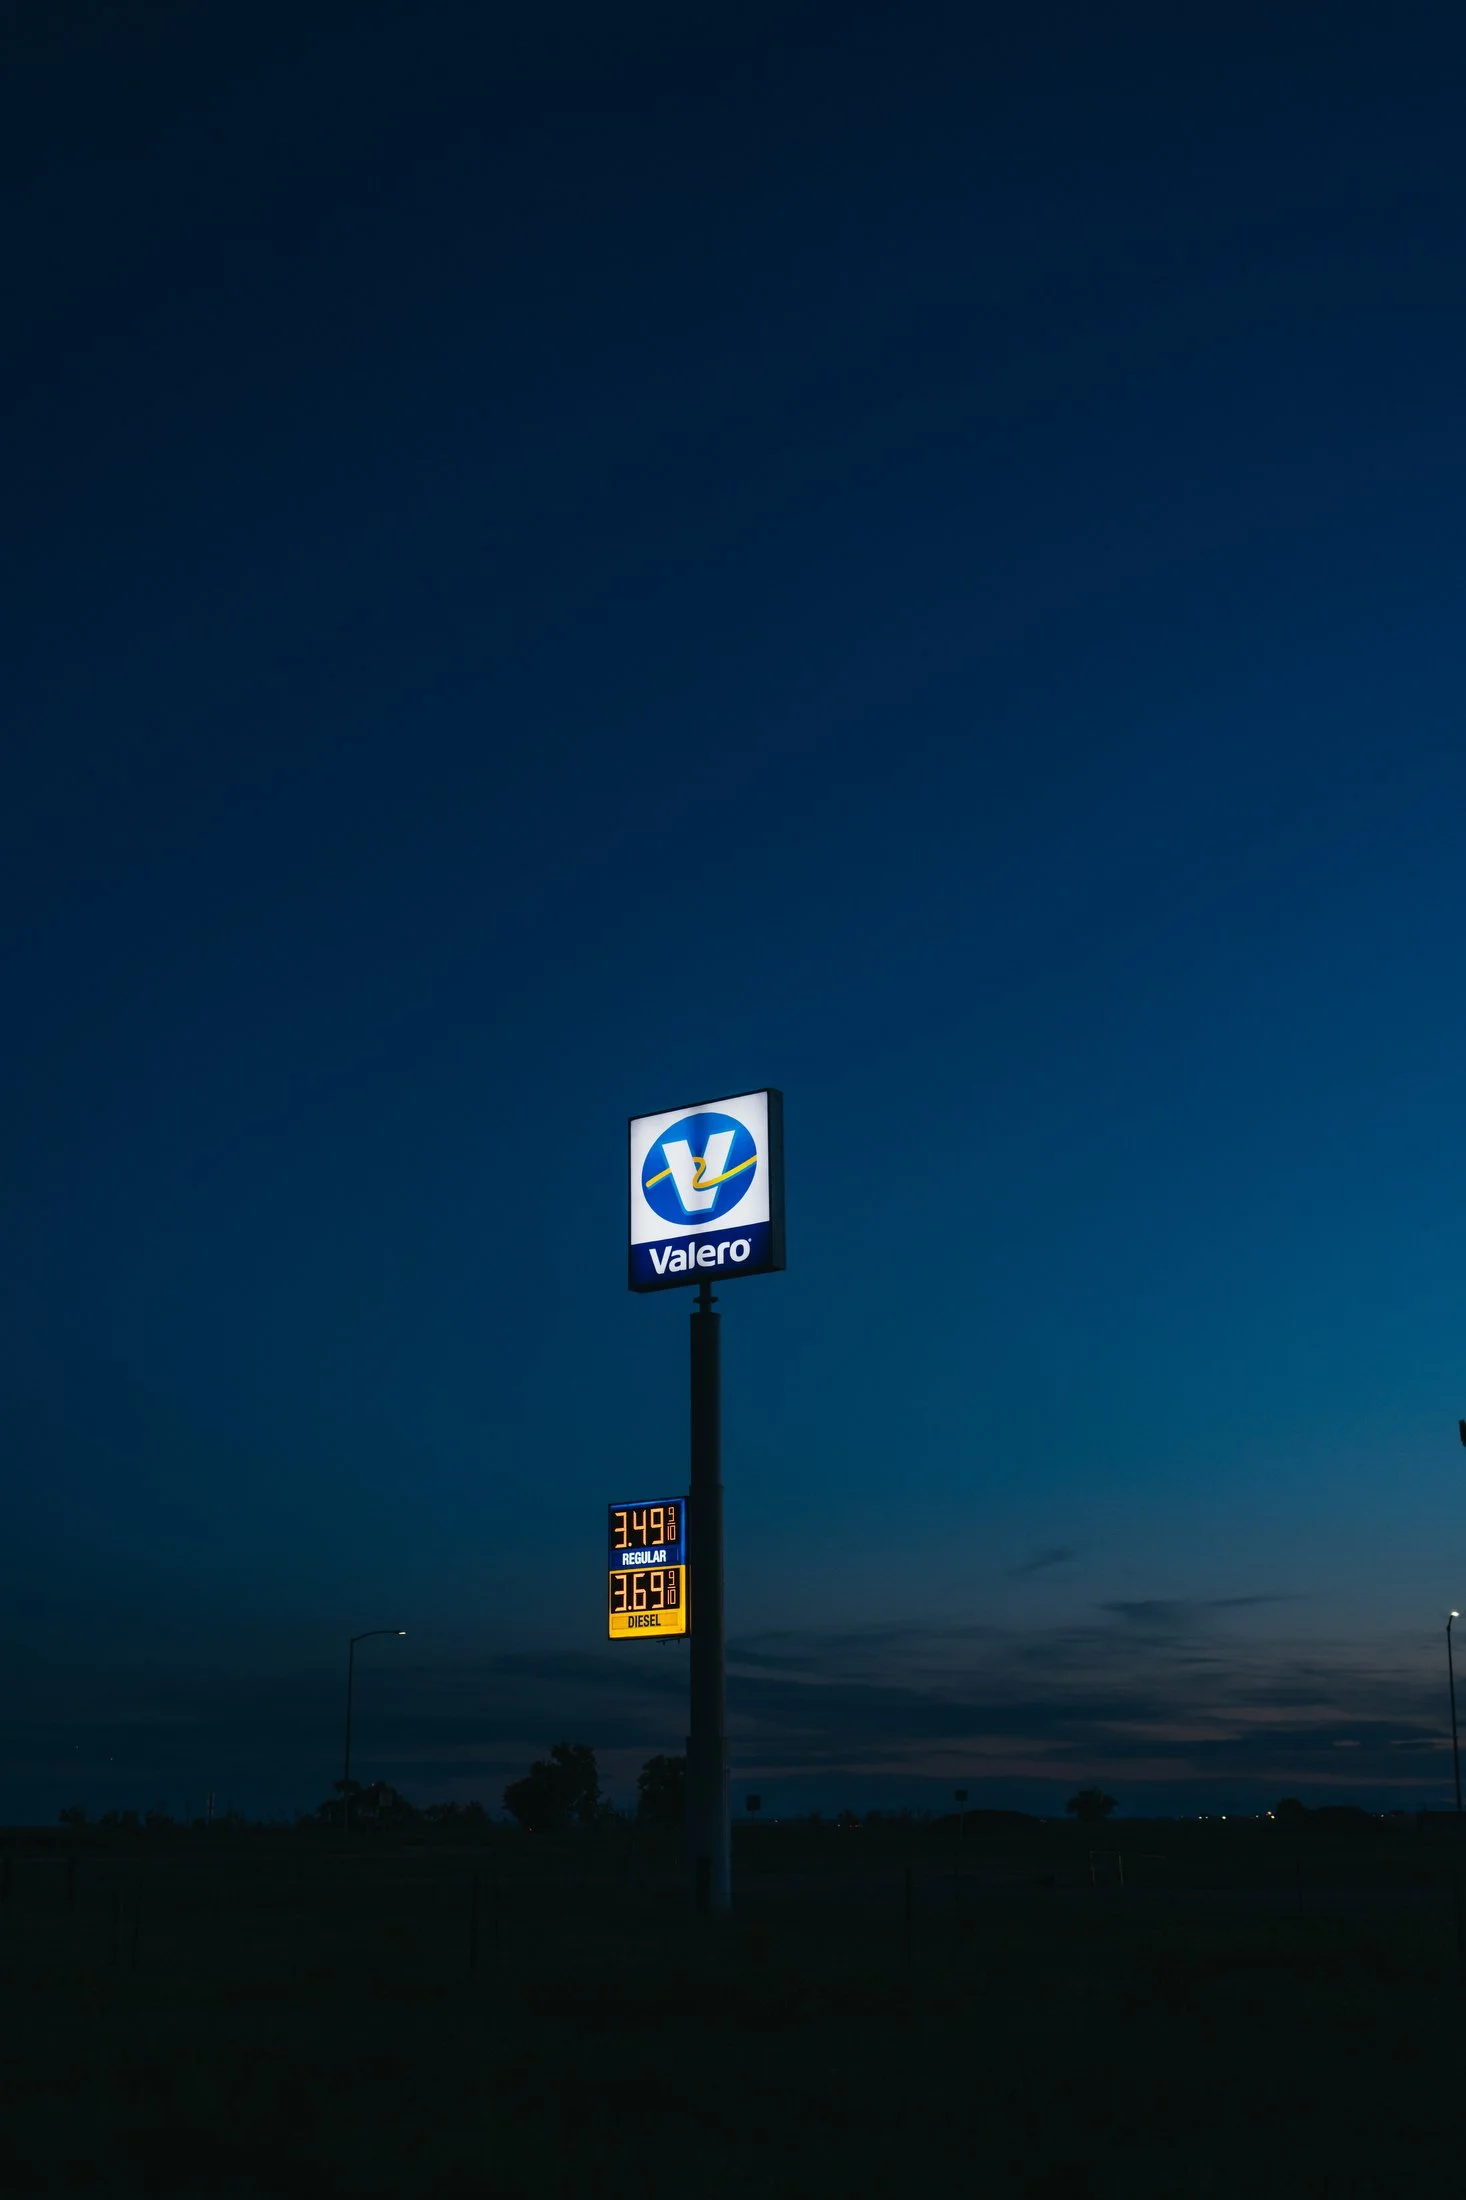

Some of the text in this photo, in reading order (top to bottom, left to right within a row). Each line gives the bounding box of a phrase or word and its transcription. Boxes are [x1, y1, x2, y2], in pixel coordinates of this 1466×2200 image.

[649, 1238, 751, 1275] Valero
[614, 1507, 664, 1549] 3.49
[622, 1550, 667, 1566] REGULAR
[614, 1571, 664, 1612] 3.69
[628, 1614, 661, 1628] DIESEL
